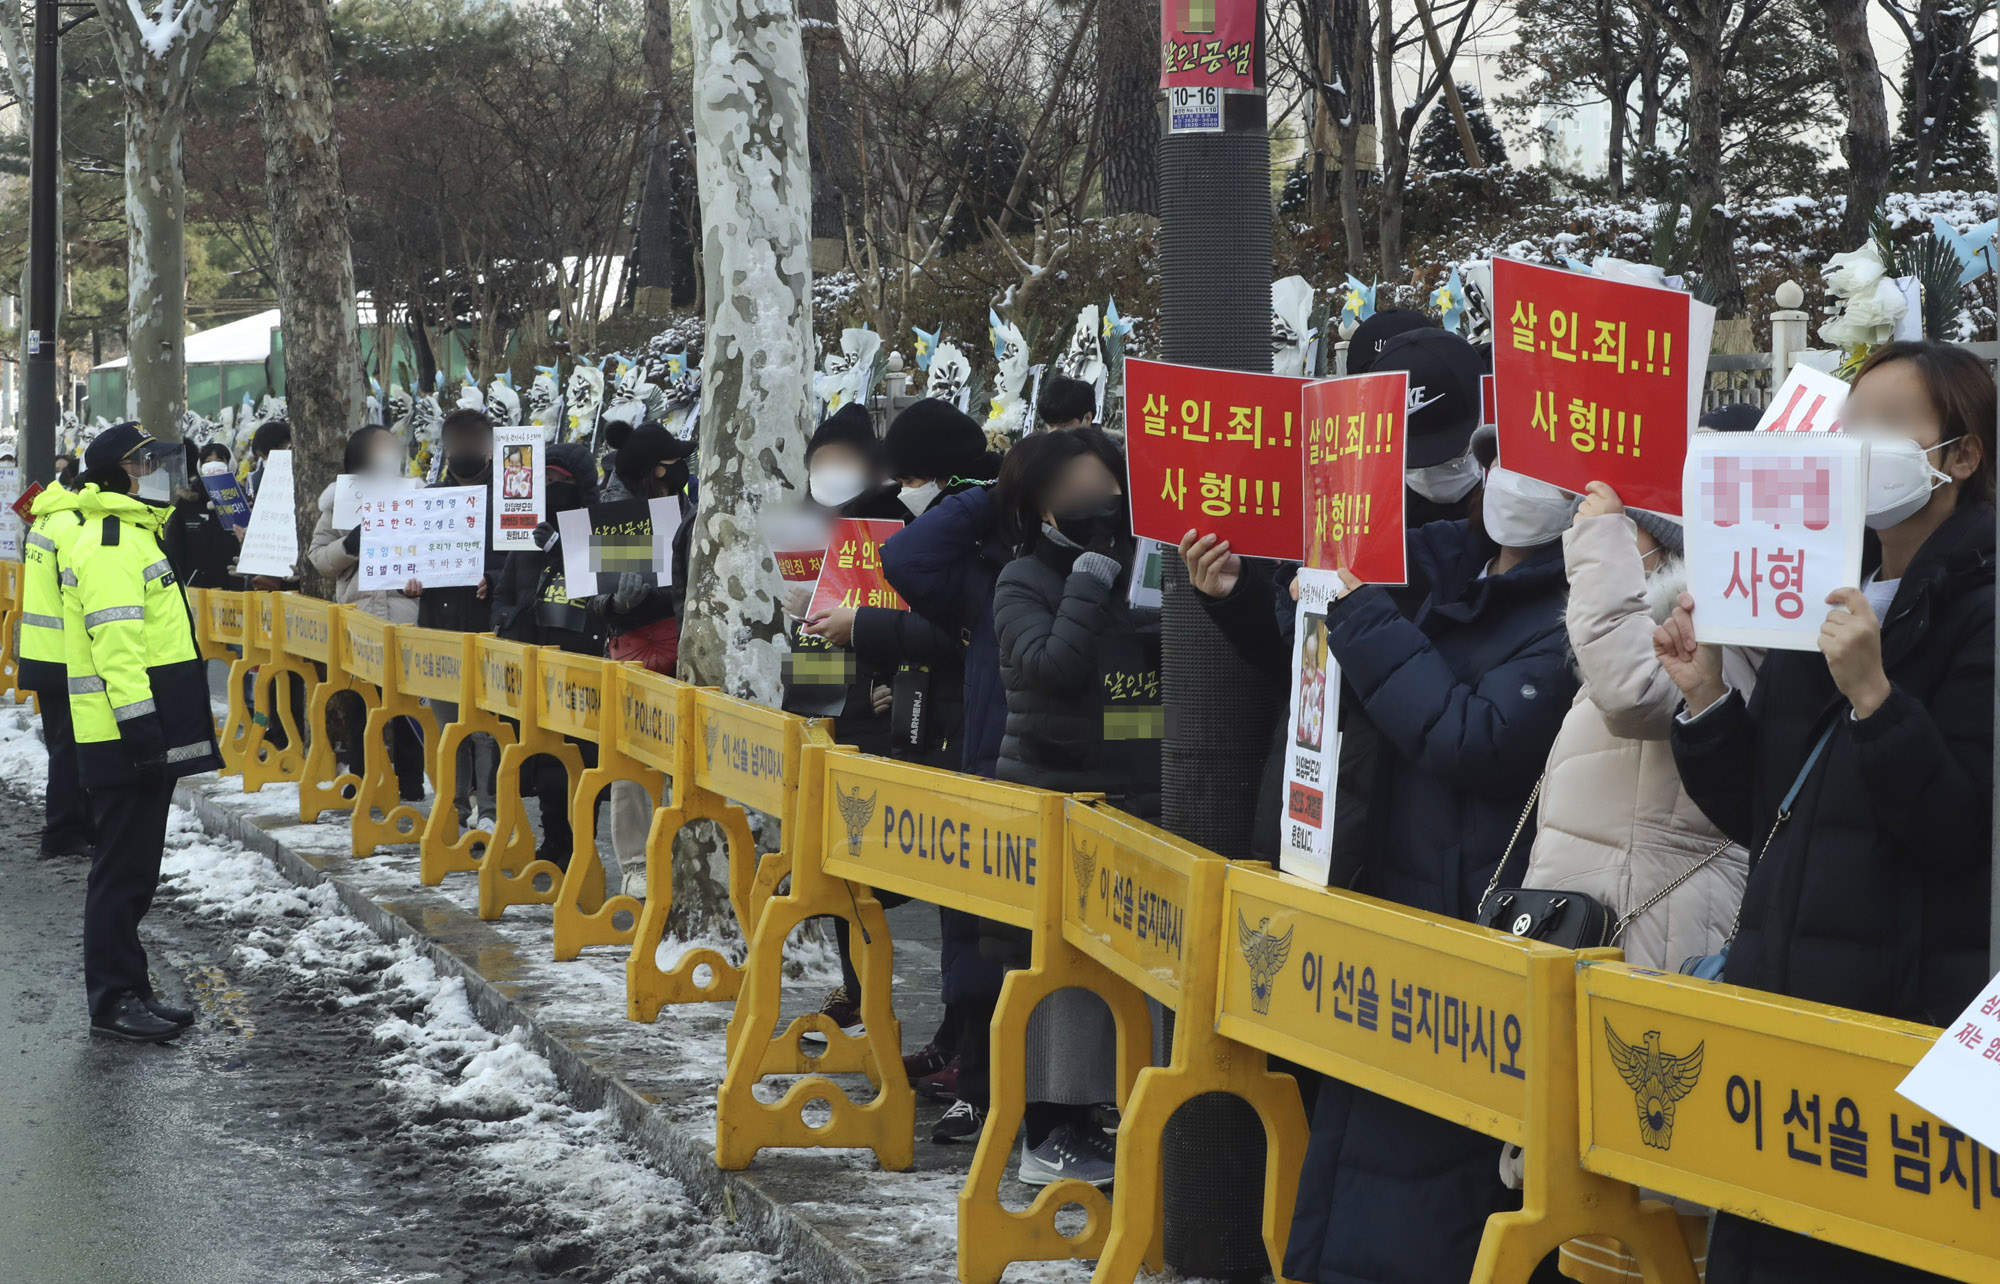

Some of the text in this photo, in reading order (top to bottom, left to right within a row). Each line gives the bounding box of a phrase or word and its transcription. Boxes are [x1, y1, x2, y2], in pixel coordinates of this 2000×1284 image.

[1163, 40, 1251, 75] 살인공범
[1174, 87, 1216, 106] 10-16
[1510, 300, 1672, 376] 살.인.죄.!!
[1142, 393, 1303, 449] 살.인.죄.!
[1309, 411, 1393, 465] 살.인.죄.!!
[808, 557, 824, 571] 처
[838, 540, 885, 570] 살.인.
[1724, 546, 1806, 620] 사형
[295, 615, 317, 641] POLICE
[491, 663, 515, 694] POLICE
[635, 699, 662, 742] POLICE
[910, 691, 922, 745] MARHEN.J
[732, 735, 748, 774] 선을
[884, 804, 1037, 887] POLICE LINE
[1100, 866, 1110, 918] 이
[1113, 870, 1133, 931] 선을
[1302, 951, 1526, 1081] 이 선을 넘지마시오
[1726, 1075, 2000, 1210] 이 선을 넘지
